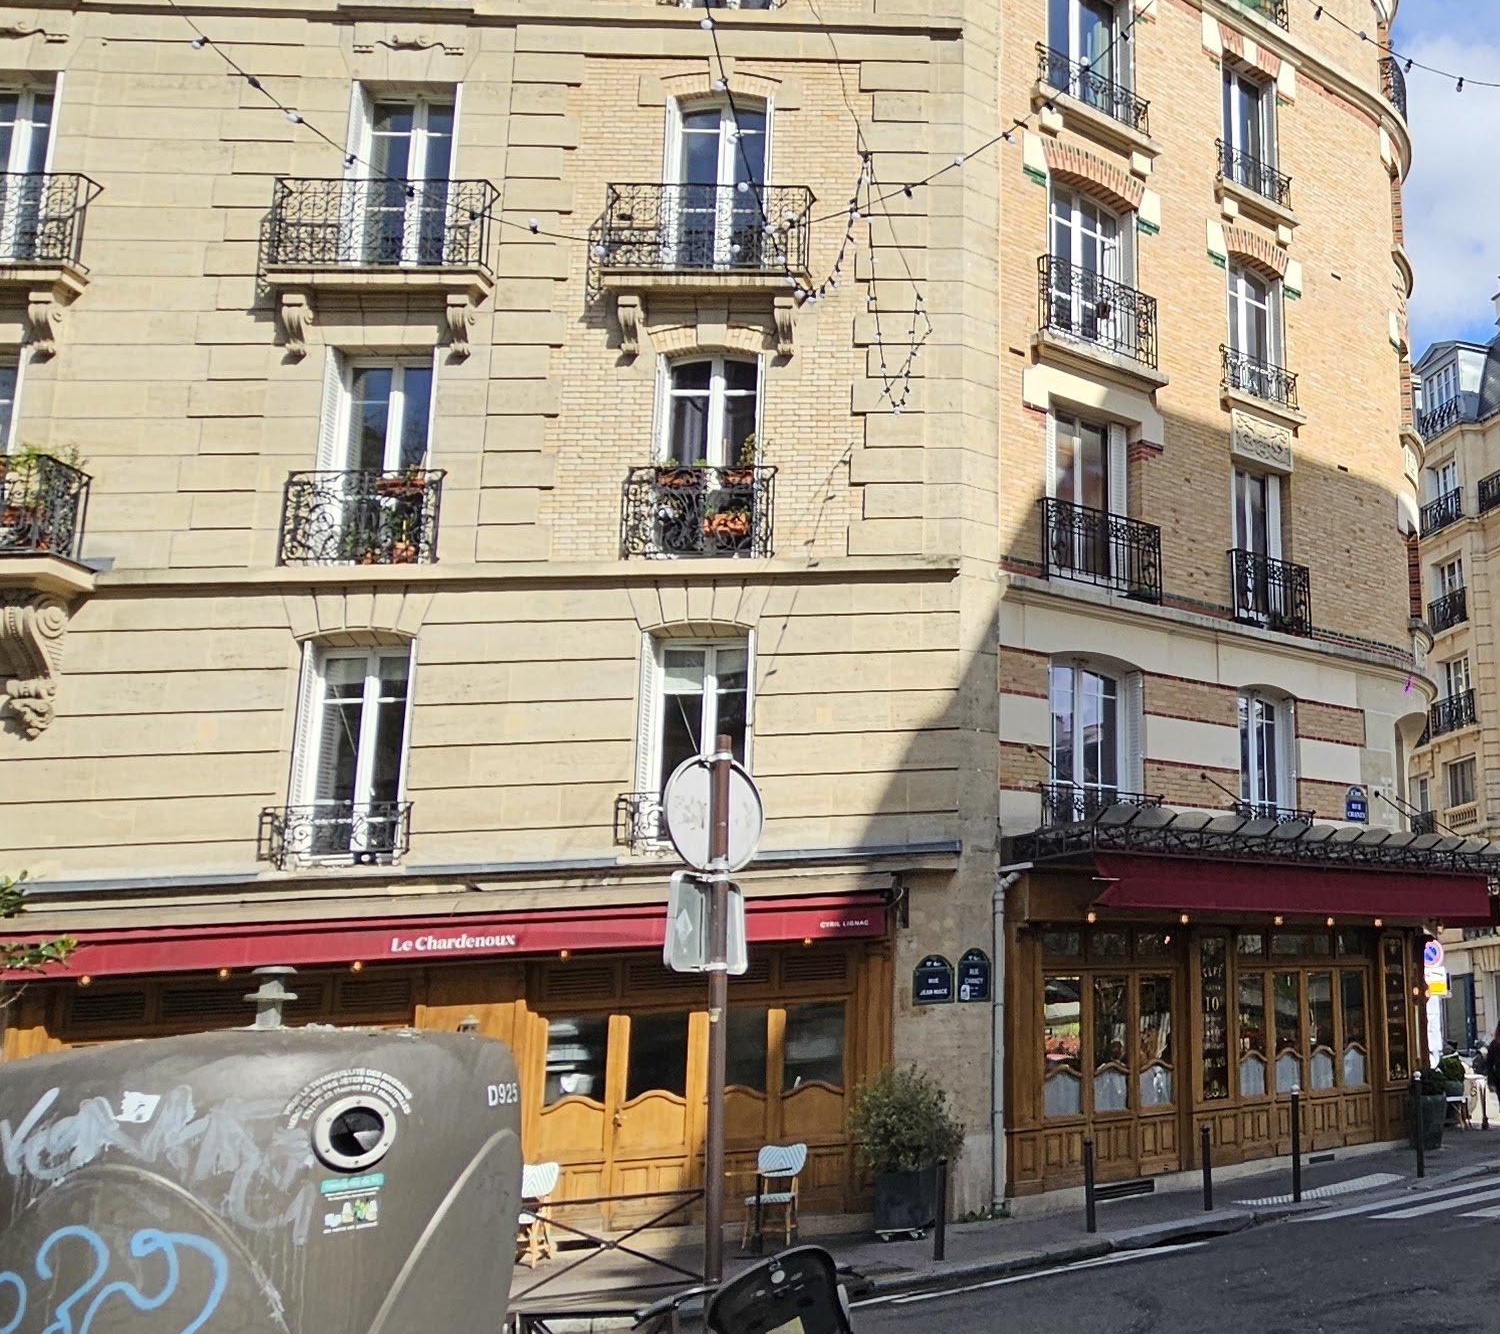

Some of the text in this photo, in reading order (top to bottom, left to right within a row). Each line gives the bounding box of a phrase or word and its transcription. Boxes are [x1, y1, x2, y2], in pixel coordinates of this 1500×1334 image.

[391, 933, 516, 952] Le Chardenoux
[488, 1082, 518, 1106] D925
